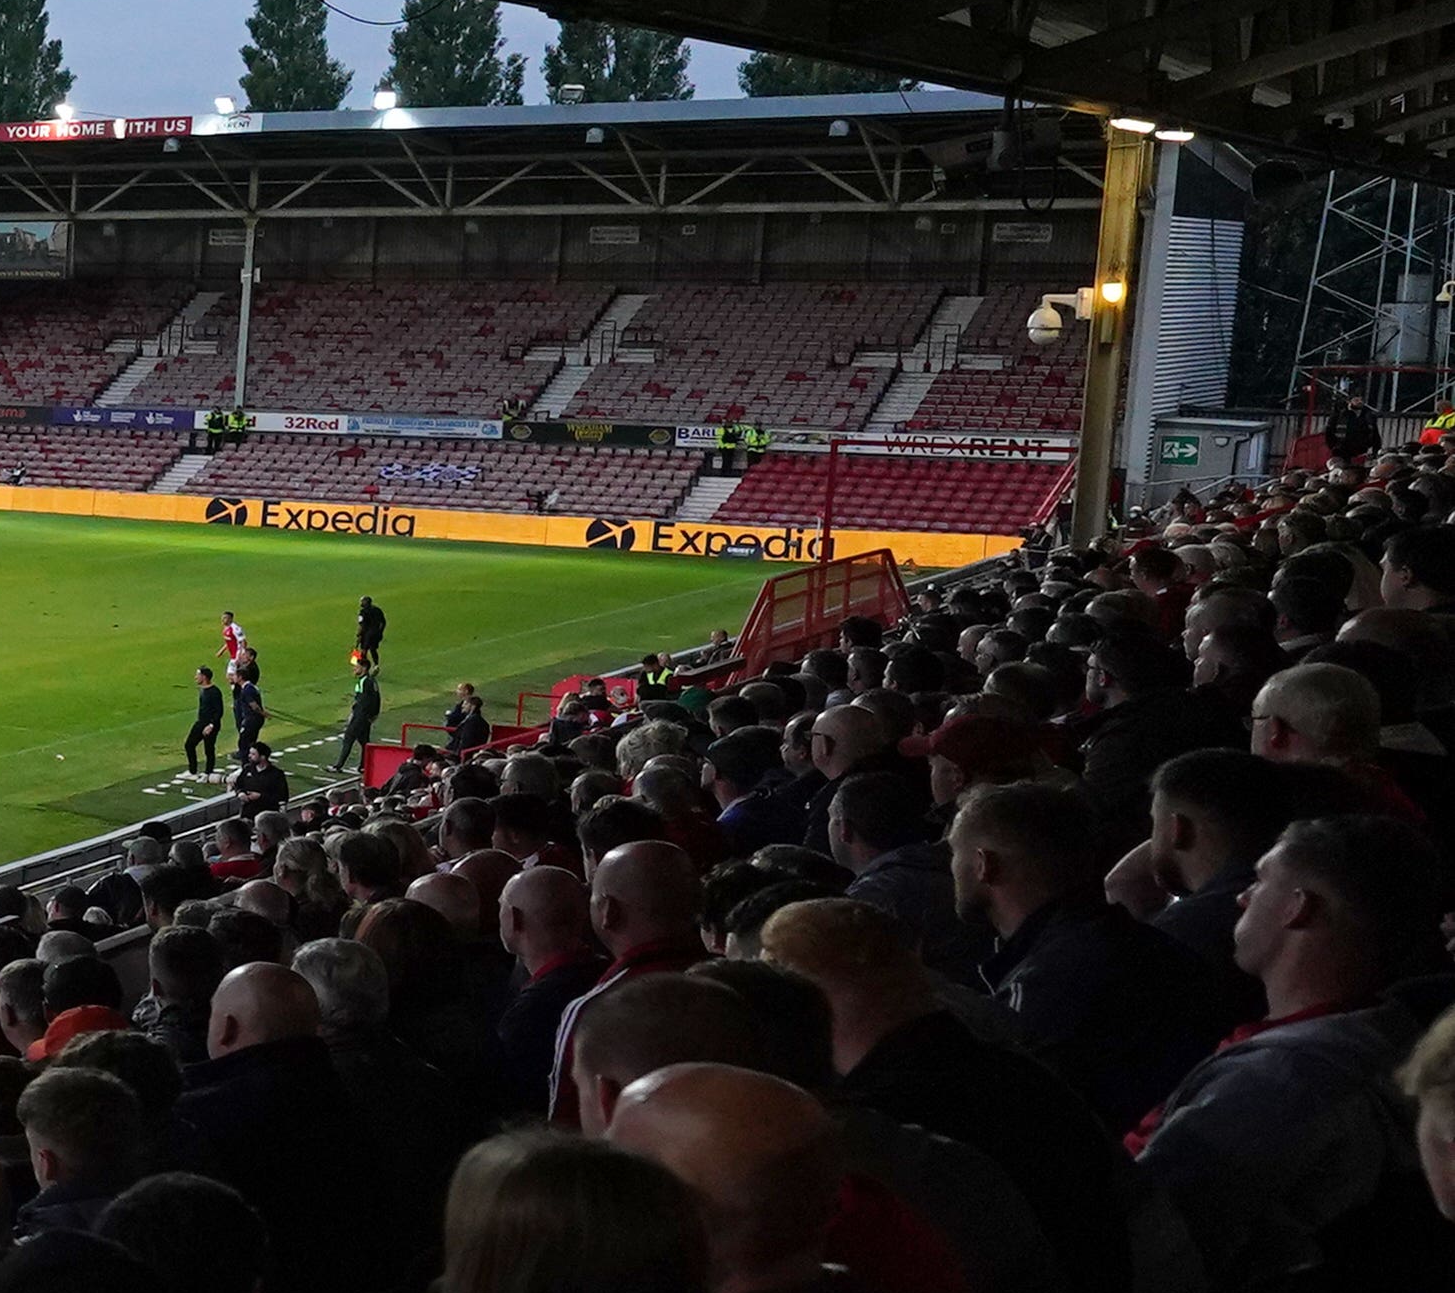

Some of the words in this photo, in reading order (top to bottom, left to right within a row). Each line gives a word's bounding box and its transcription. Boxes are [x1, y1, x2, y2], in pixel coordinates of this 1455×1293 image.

[6, 124, 51, 139] YOUR
[55, 122, 106, 138] HOME
[163, 119, 187, 133] US
[284, 416, 340, 431] 32Red
[883, 434, 1051, 458] WREXRENT
[261, 500, 416, 537] Expedia
